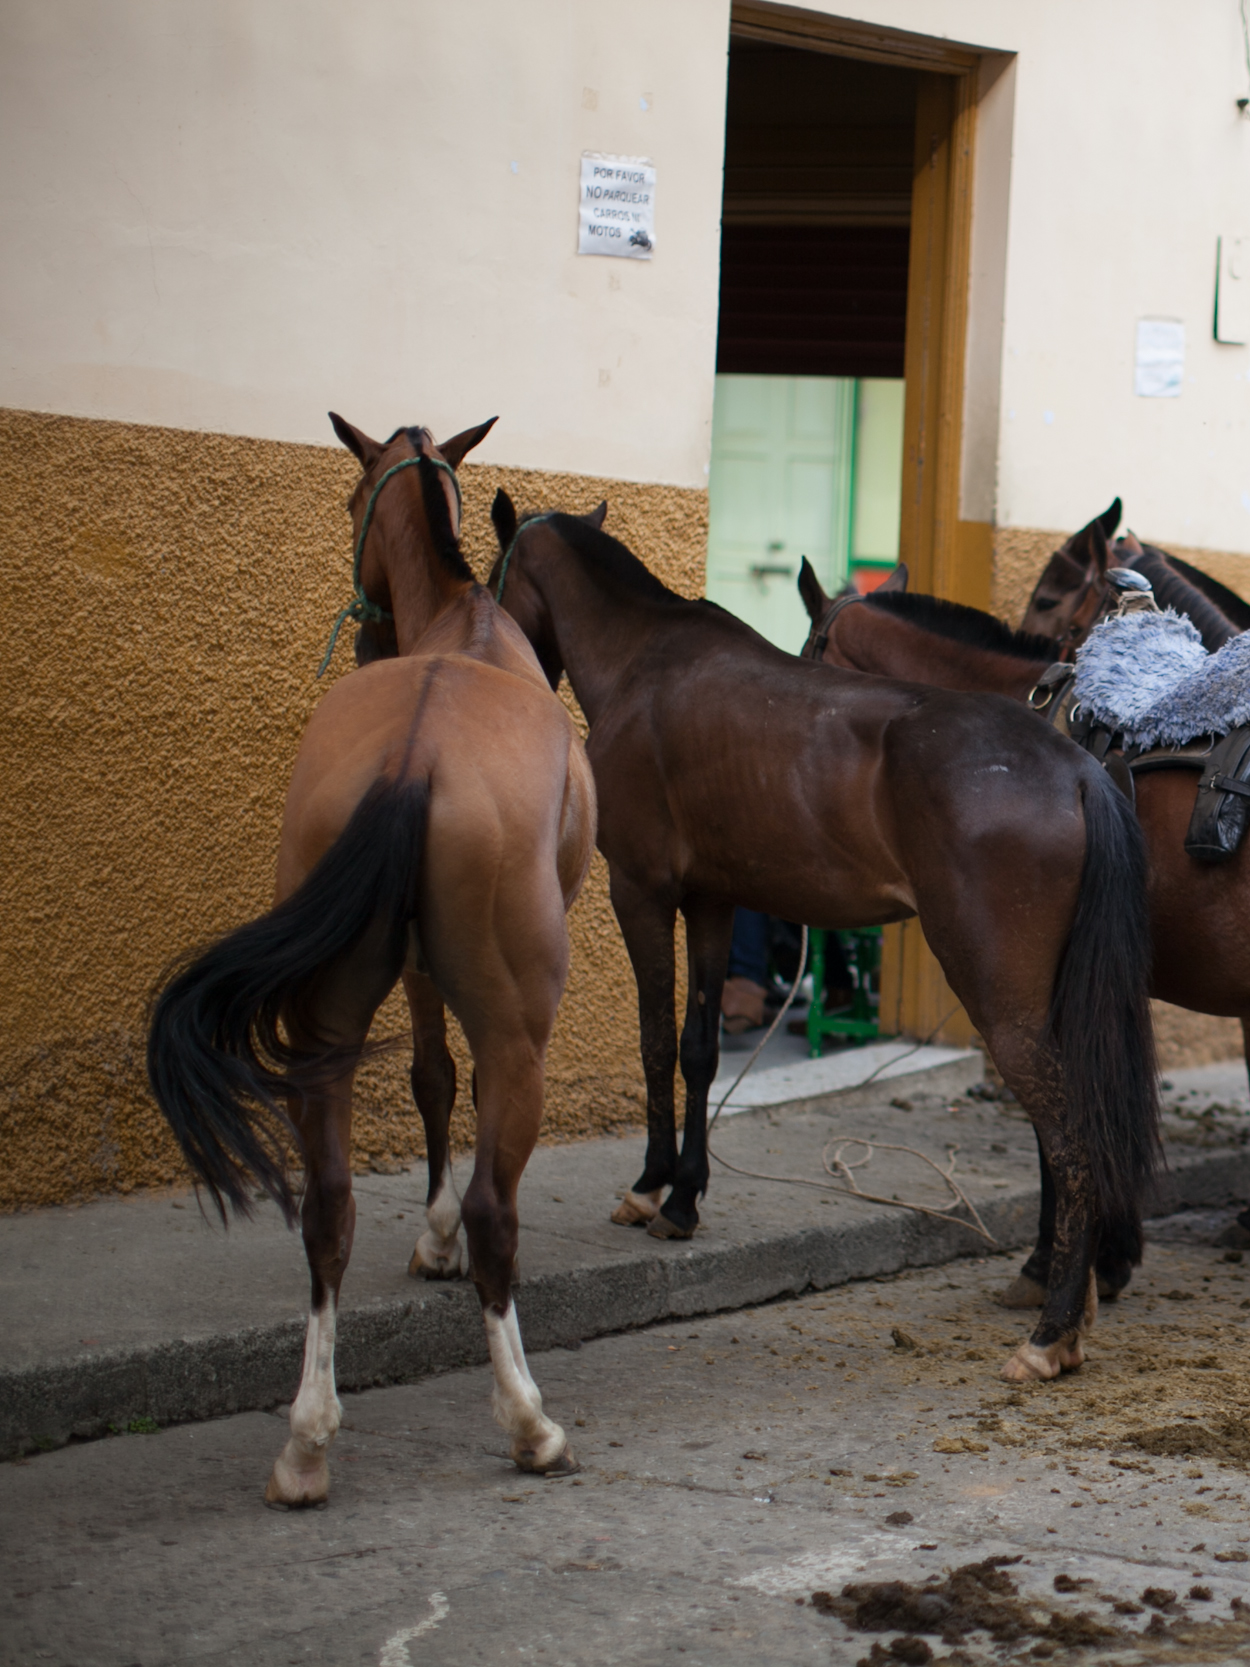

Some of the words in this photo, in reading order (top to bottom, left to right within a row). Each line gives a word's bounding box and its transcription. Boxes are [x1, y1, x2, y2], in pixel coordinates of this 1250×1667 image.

[593, 167, 614, 179] POR
[615, 170, 645, 184] FAVOR
[585, 185, 602, 199] NO
[602, 189, 650, 205] PARQUEAR
[588, 224, 622, 238] MOTOS
